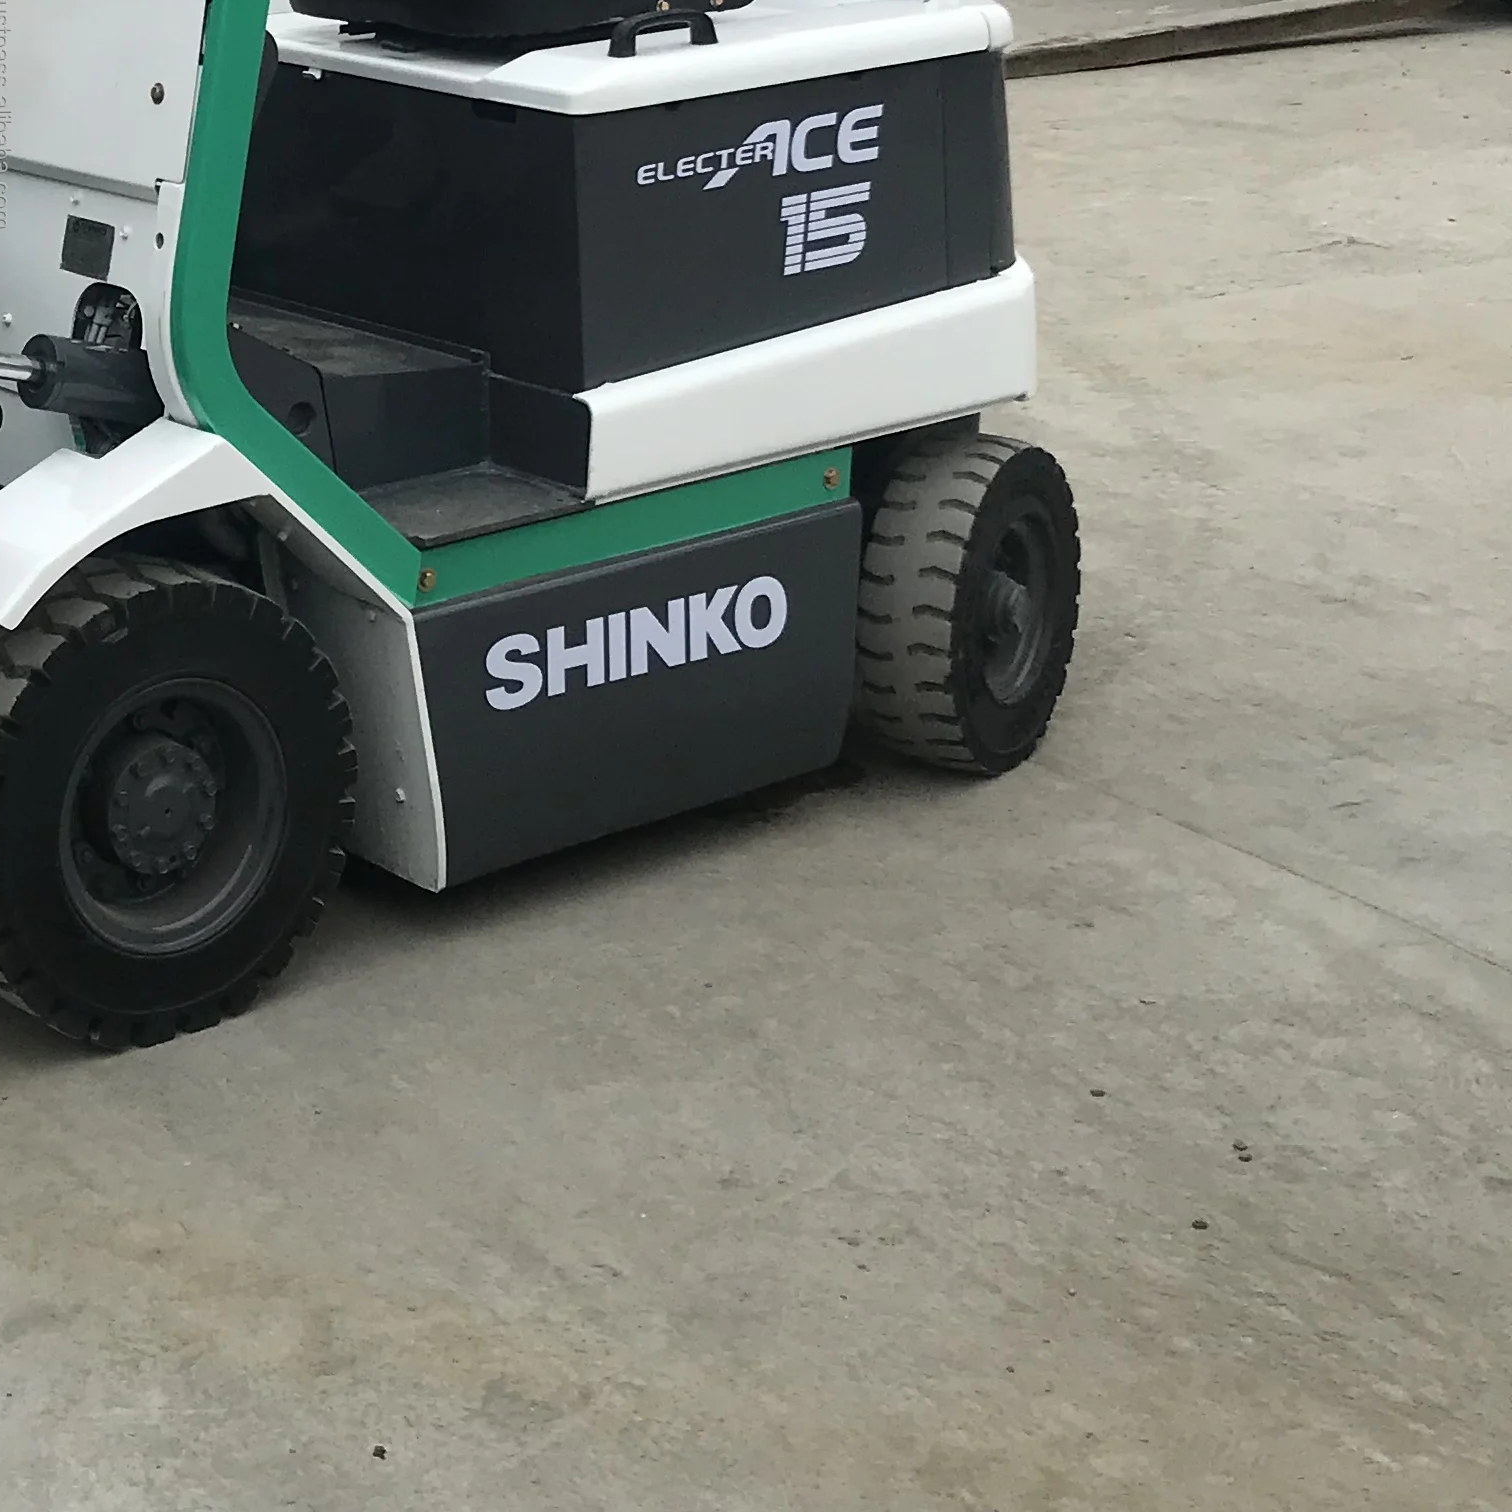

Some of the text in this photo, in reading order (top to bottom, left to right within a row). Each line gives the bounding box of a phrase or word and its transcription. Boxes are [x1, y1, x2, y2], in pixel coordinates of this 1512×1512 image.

[637, 104, 884, 190] ELECTER ACE
[780, 181, 872, 276] 15
[485, 576, 788, 710] SHINKO
